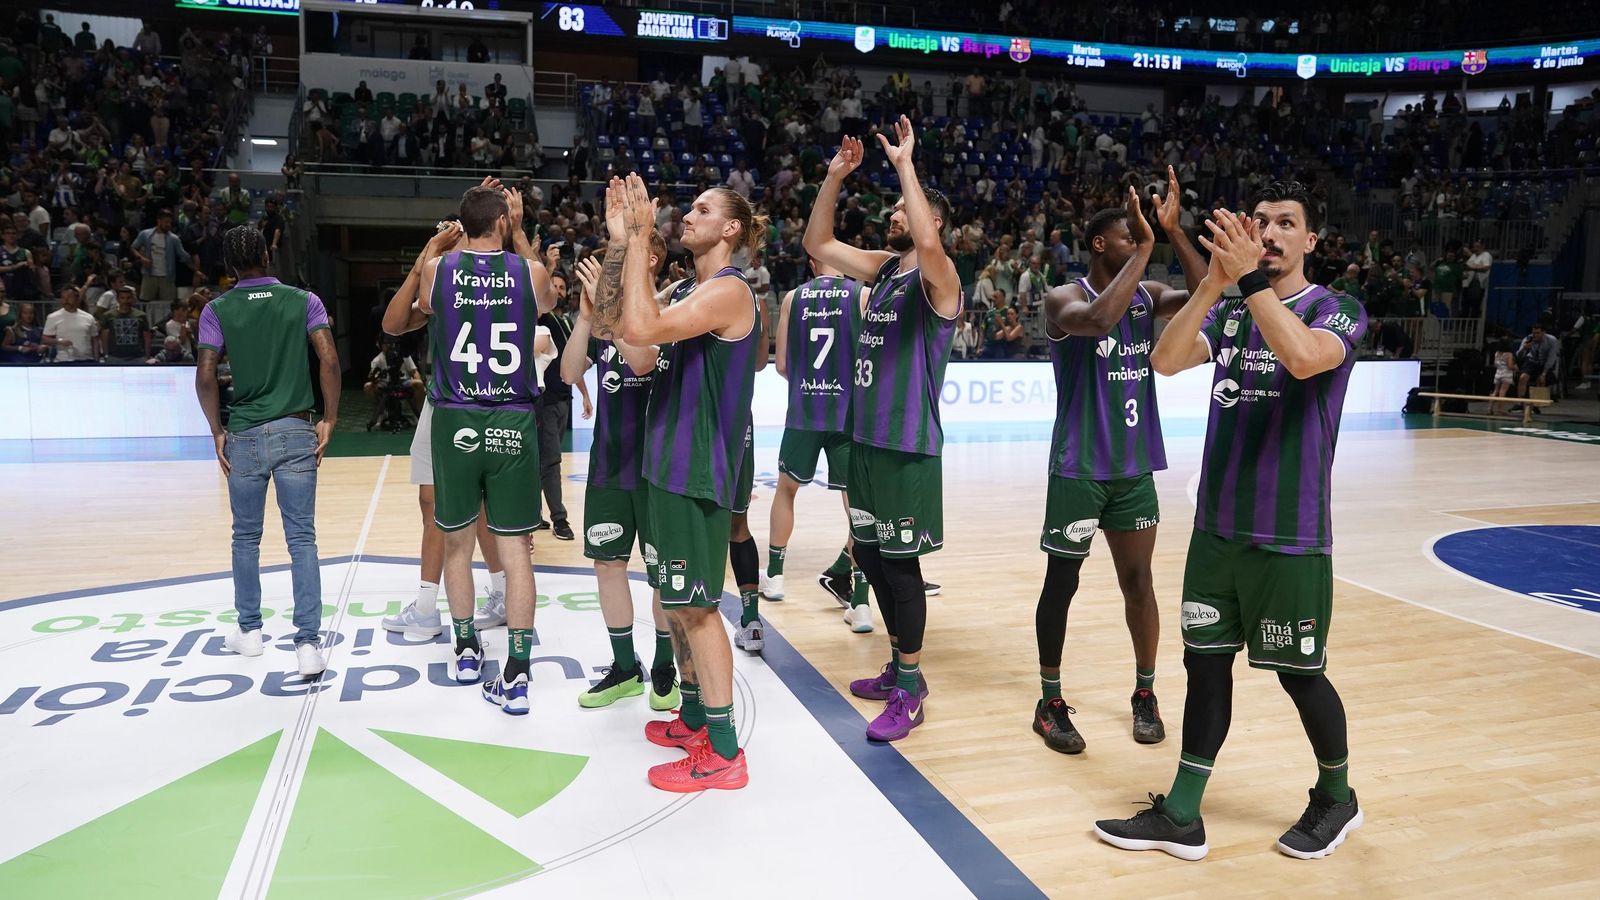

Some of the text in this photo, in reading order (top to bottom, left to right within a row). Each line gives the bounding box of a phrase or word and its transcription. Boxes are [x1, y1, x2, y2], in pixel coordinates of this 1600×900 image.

[227, 0, 300, 9] UNICAJ
[559, 6, 585, 31] 83
[638, 12, 695, 27] JOVENTUT
[637, 23, 694, 38] BADALONA
[888, 32, 1000, 59] Unicaja VS Barça
[1072, 44, 1101, 56] Martes
[1541, 46, 1579, 57] Martes
[1067, 54, 1105, 68] 3 de junio
[1133, 52, 1181, 70] 21:15 H
[1330, 57, 1450, 76] Unicaja VS Barça
[1533, 55, 1584, 69] 3 de junio
[452, 269, 515, 288] Kravish
[801, 287, 849, 299] Barreiro
[858, 330, 884, 348] álaga
[450, 321, 521, 375] 45
[810, 328, 835, 370] 7
[1241, 347, 1279, 361] Fundac
[854, 358, 874, 388] 33
[457, 380, 518, 397] Andalucía
[800, 378, 845, 391] Andalucía
[968, 380, 1004, 405] DE
[1125, 398, 1139, 427] 3
[484, 428, 523, 440] COSTA
[485, 438, 522, 448] DEL SOL
[485, 445, 521, 456] MÁLAGA
[1266, 621, 1293, 636] má
[1262, 629, 1294, 648] laga
